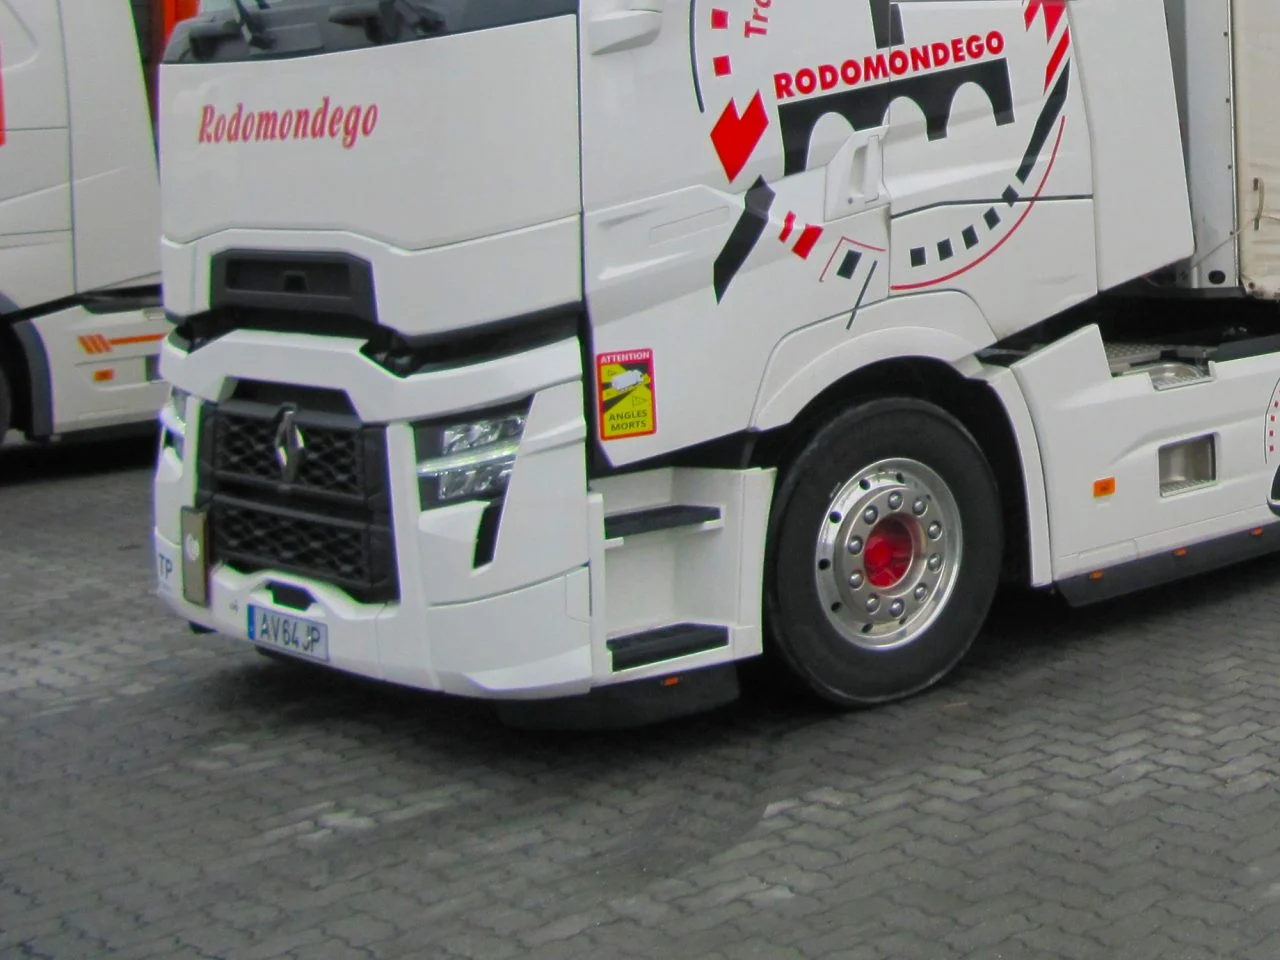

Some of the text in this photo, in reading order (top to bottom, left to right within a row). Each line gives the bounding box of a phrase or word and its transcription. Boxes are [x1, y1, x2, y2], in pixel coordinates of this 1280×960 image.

[773, 30, 1006, 100] RODOMONDEGO
[199, 96, 379, 149] Rodomondego
[601, 351, 650, 363] ATTENTION
[608, 409, 648, 421] ANGLES
[610, 420, 647, 432] MORTS
[159, 554, 173, 580] TP
